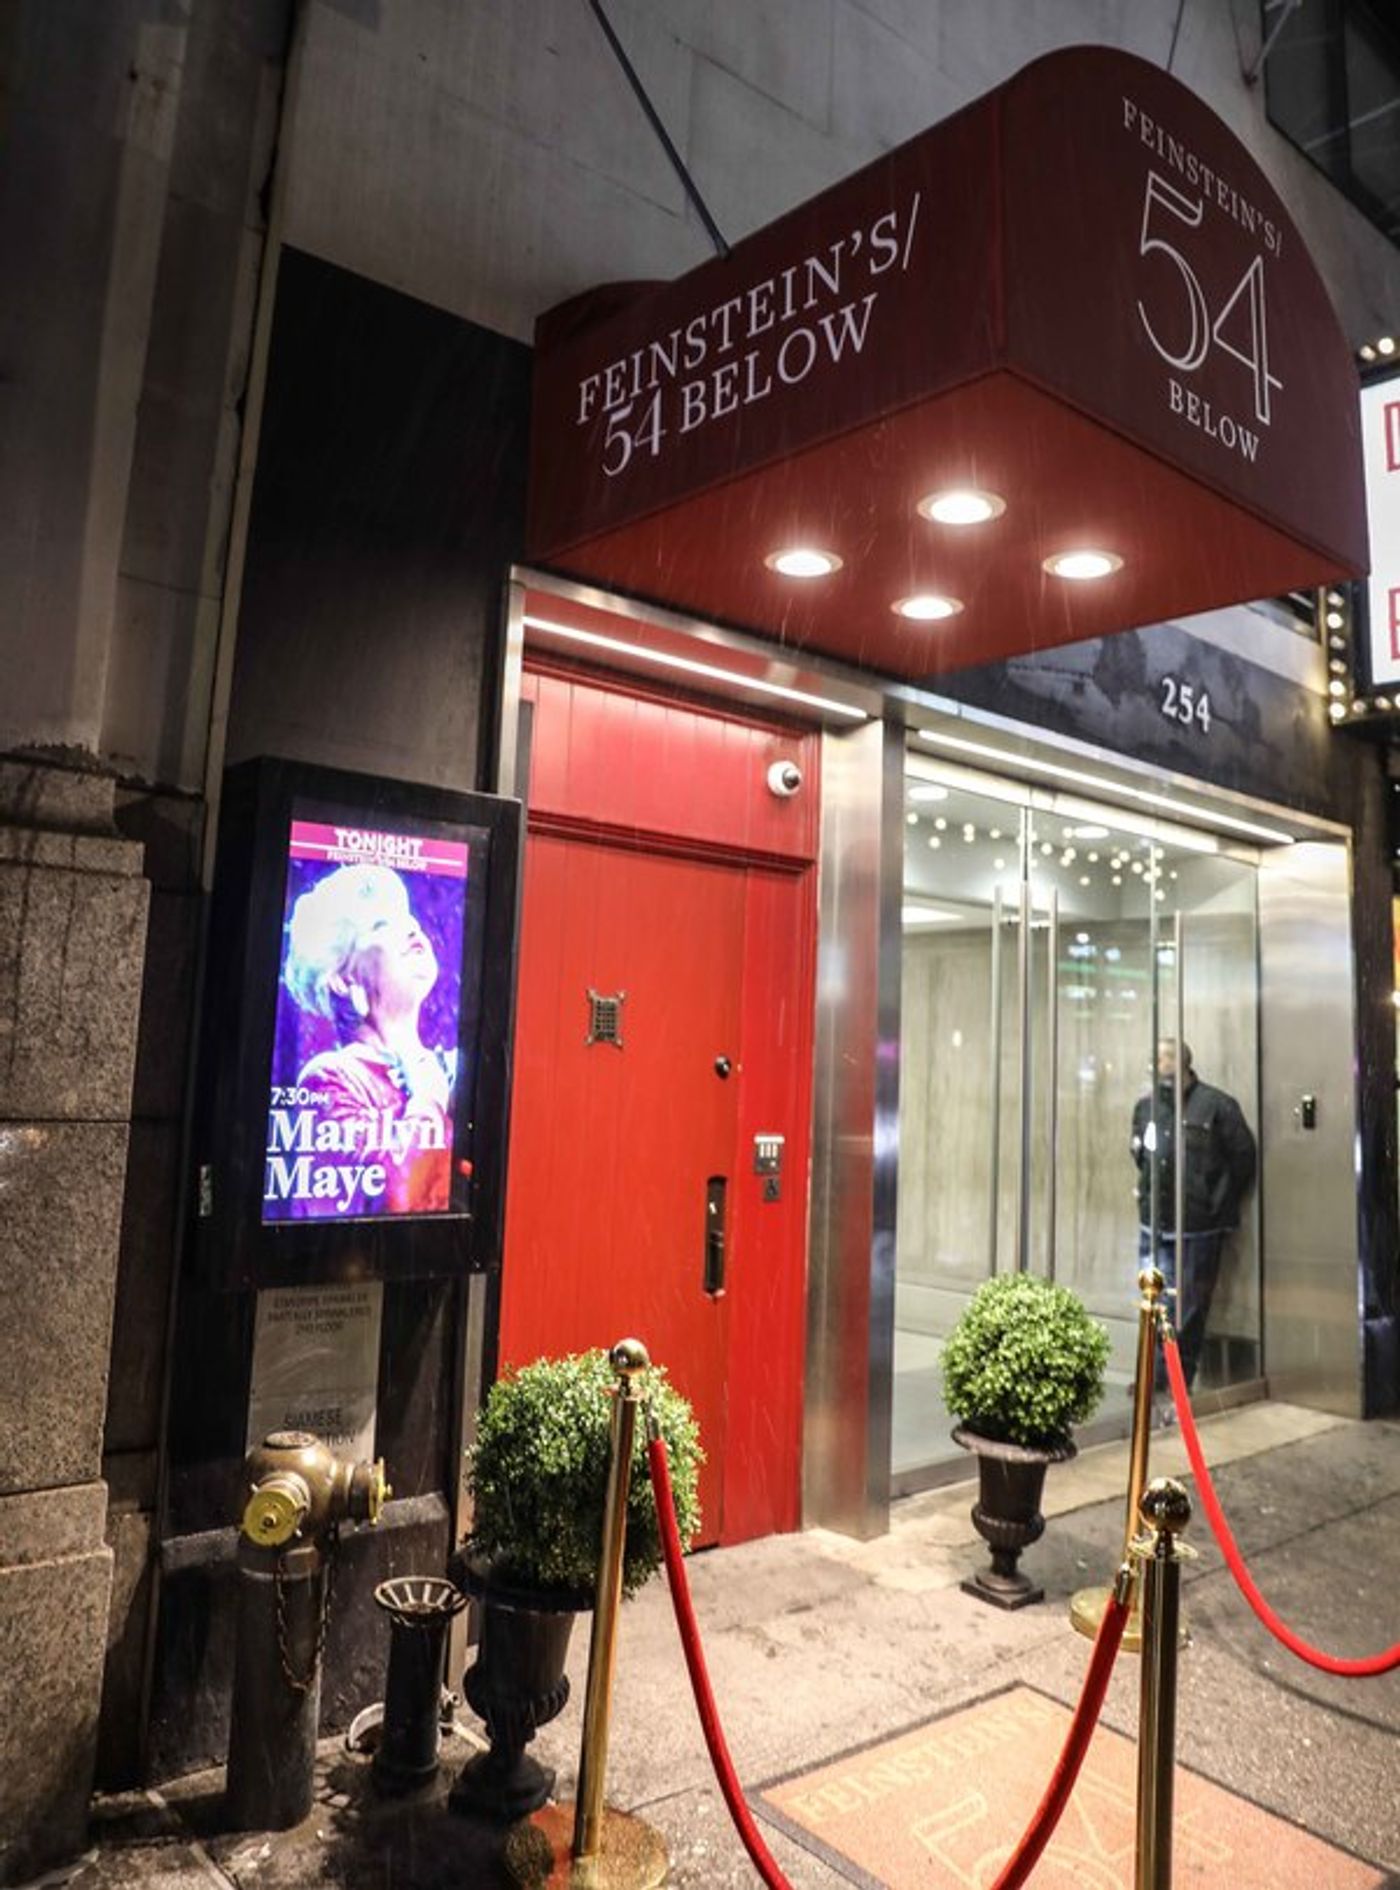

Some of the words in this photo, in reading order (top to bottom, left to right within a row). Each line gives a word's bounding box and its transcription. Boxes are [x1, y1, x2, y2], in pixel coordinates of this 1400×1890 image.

[1138, 170, 1283, 425] 54
[602, 388, 666, 476] 54
[679, 293, 878, 434] BELOW
[1169, 378, 1260, 462] BELOW
[1161, 677, 1211, 733] 254
[334, 828, 424, 858] TONIGHT
[266, 1110, 447, 1165] Marilyn
[264, 1155, 386, 1211] Maye
